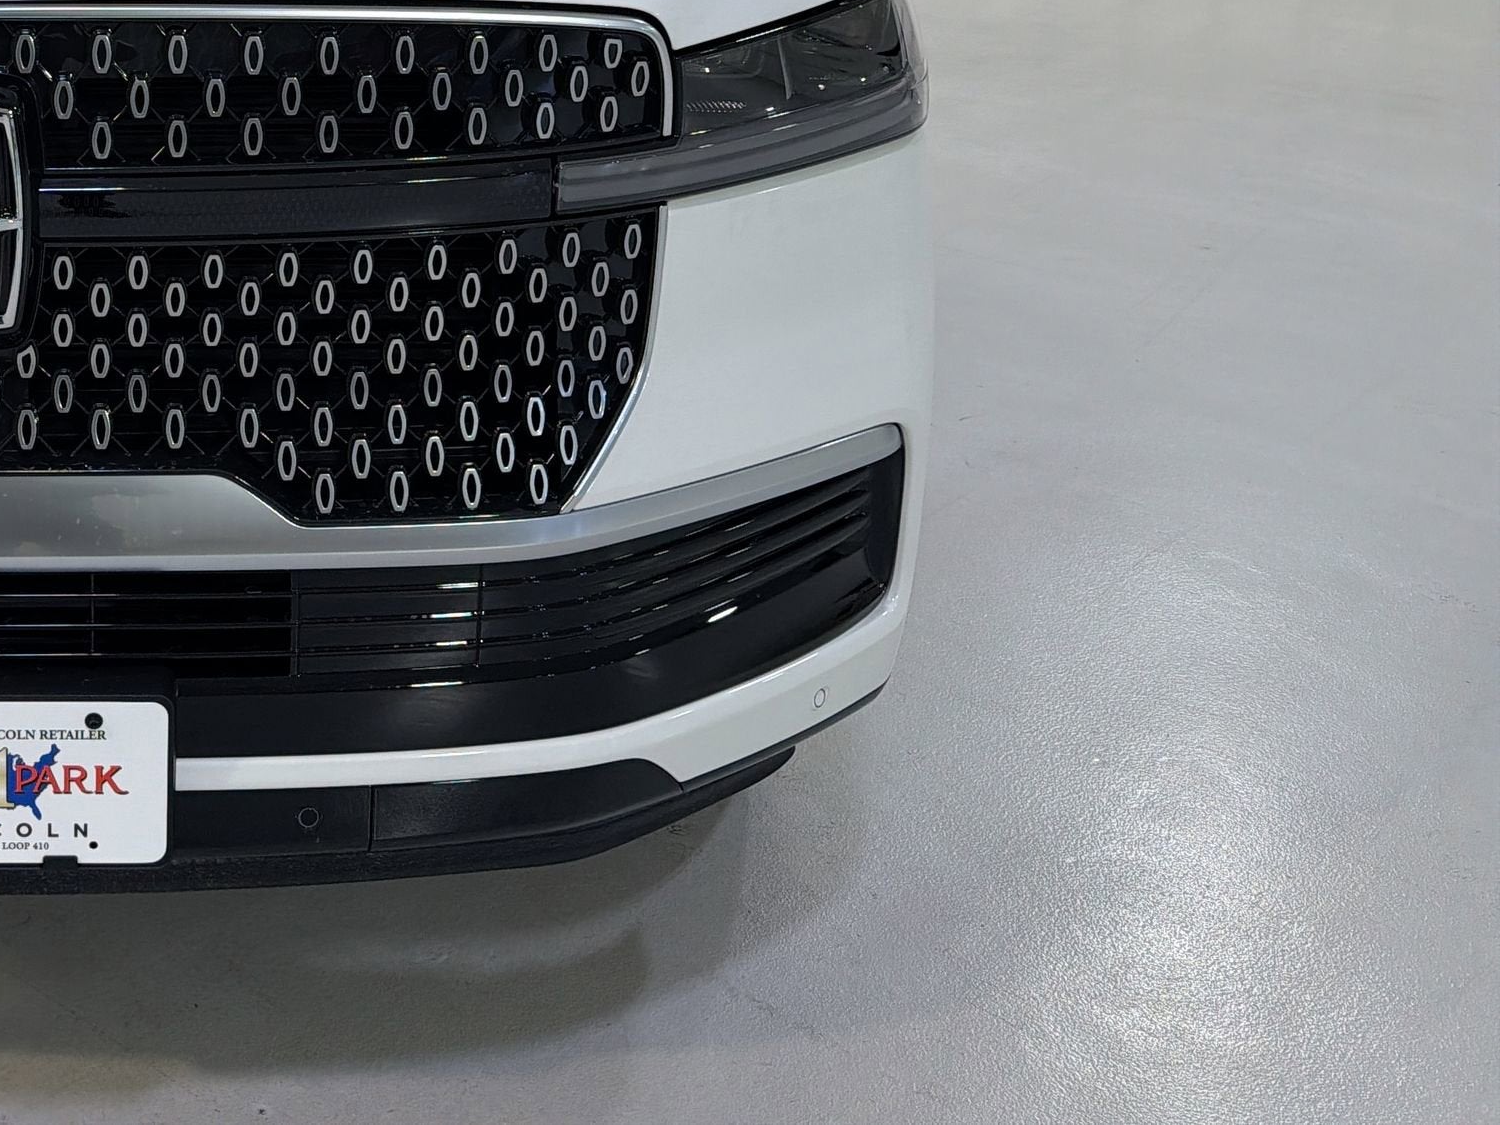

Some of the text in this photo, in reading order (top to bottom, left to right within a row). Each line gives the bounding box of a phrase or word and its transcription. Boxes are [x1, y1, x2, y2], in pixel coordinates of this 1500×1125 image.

[39, 729, 107, 741] RETAILER
[14, 764, 130, 796] PARK
[2, 842, 31, 851] LOOP
[32, 842, 50, 851] 410
